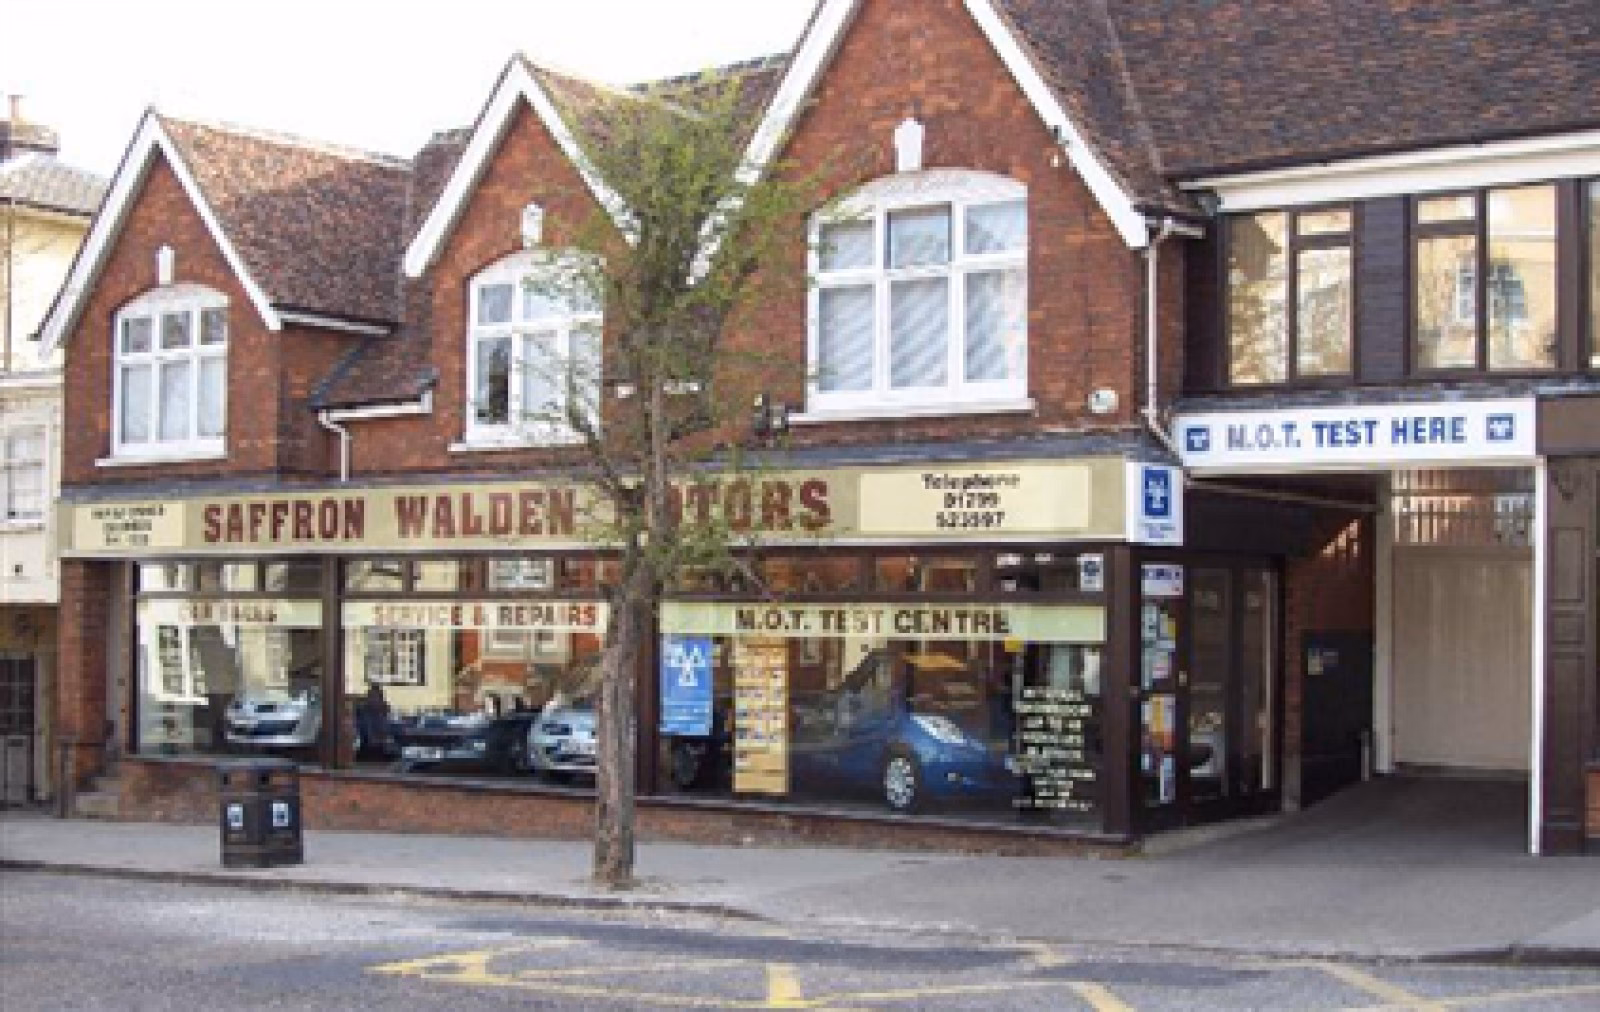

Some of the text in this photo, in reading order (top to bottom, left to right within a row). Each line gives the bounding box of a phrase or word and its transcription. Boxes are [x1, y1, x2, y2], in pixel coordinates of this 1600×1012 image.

[1227, 416, 1467, 450] M.O.T. TEST HERE
[203, 477, 834, 543] SAFFRON WALDEN OTORS
[373, 605, 463, 627] SERVICE
[498, 605, 597, 627] REPAIRS
[735, 609, 1010, 634] M.O.T. TEST CENTRE
